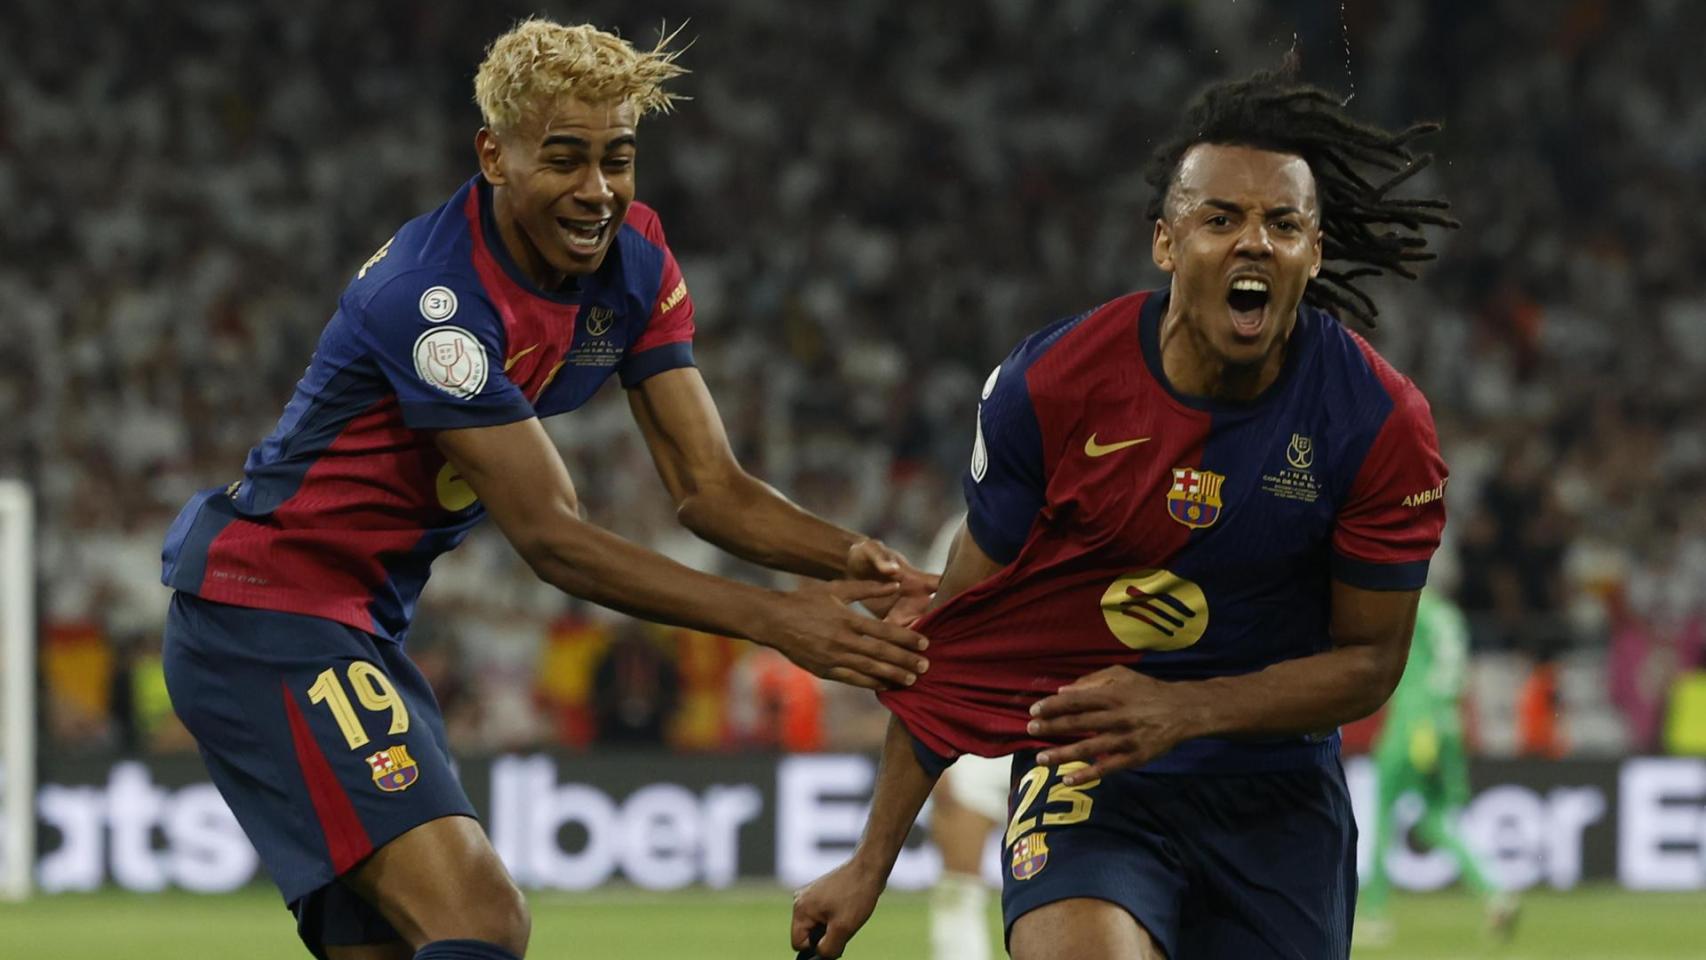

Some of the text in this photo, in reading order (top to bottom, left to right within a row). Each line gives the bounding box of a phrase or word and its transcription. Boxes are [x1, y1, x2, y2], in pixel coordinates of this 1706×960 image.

[429, 298, 448, 309] 31
[1280, 470, 1315, 482] FINAL
[307, 660, 410, 751] 19
[36, 760, 260, 893] ats
[1006, 760, 1101, 850] 23
